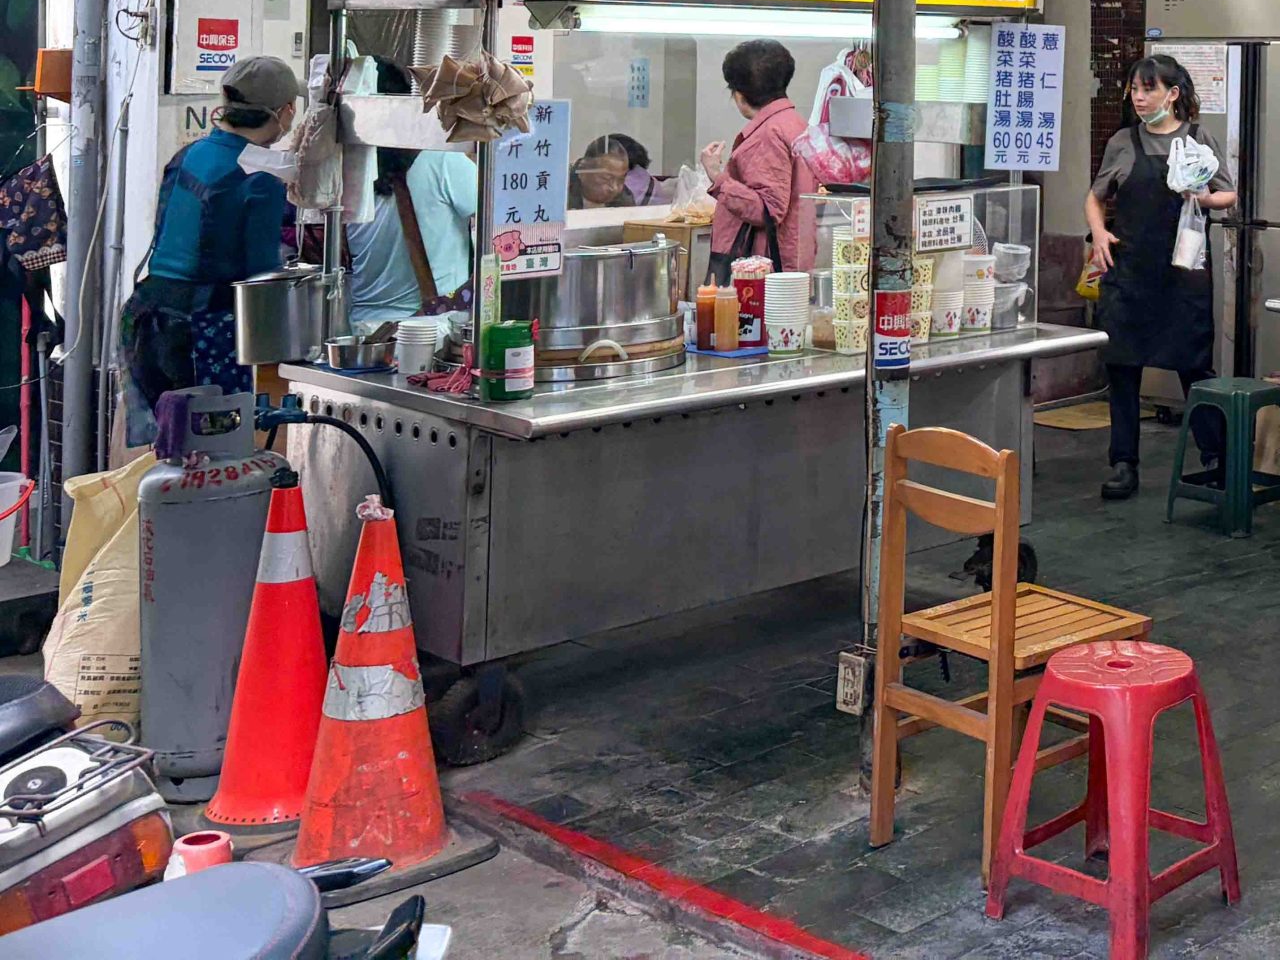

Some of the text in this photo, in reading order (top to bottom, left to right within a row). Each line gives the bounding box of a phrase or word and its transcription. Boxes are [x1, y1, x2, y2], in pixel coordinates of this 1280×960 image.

[199, 34, 236, 46] 中興保全
[533, 105, 553, 223] 新竹貢丸
